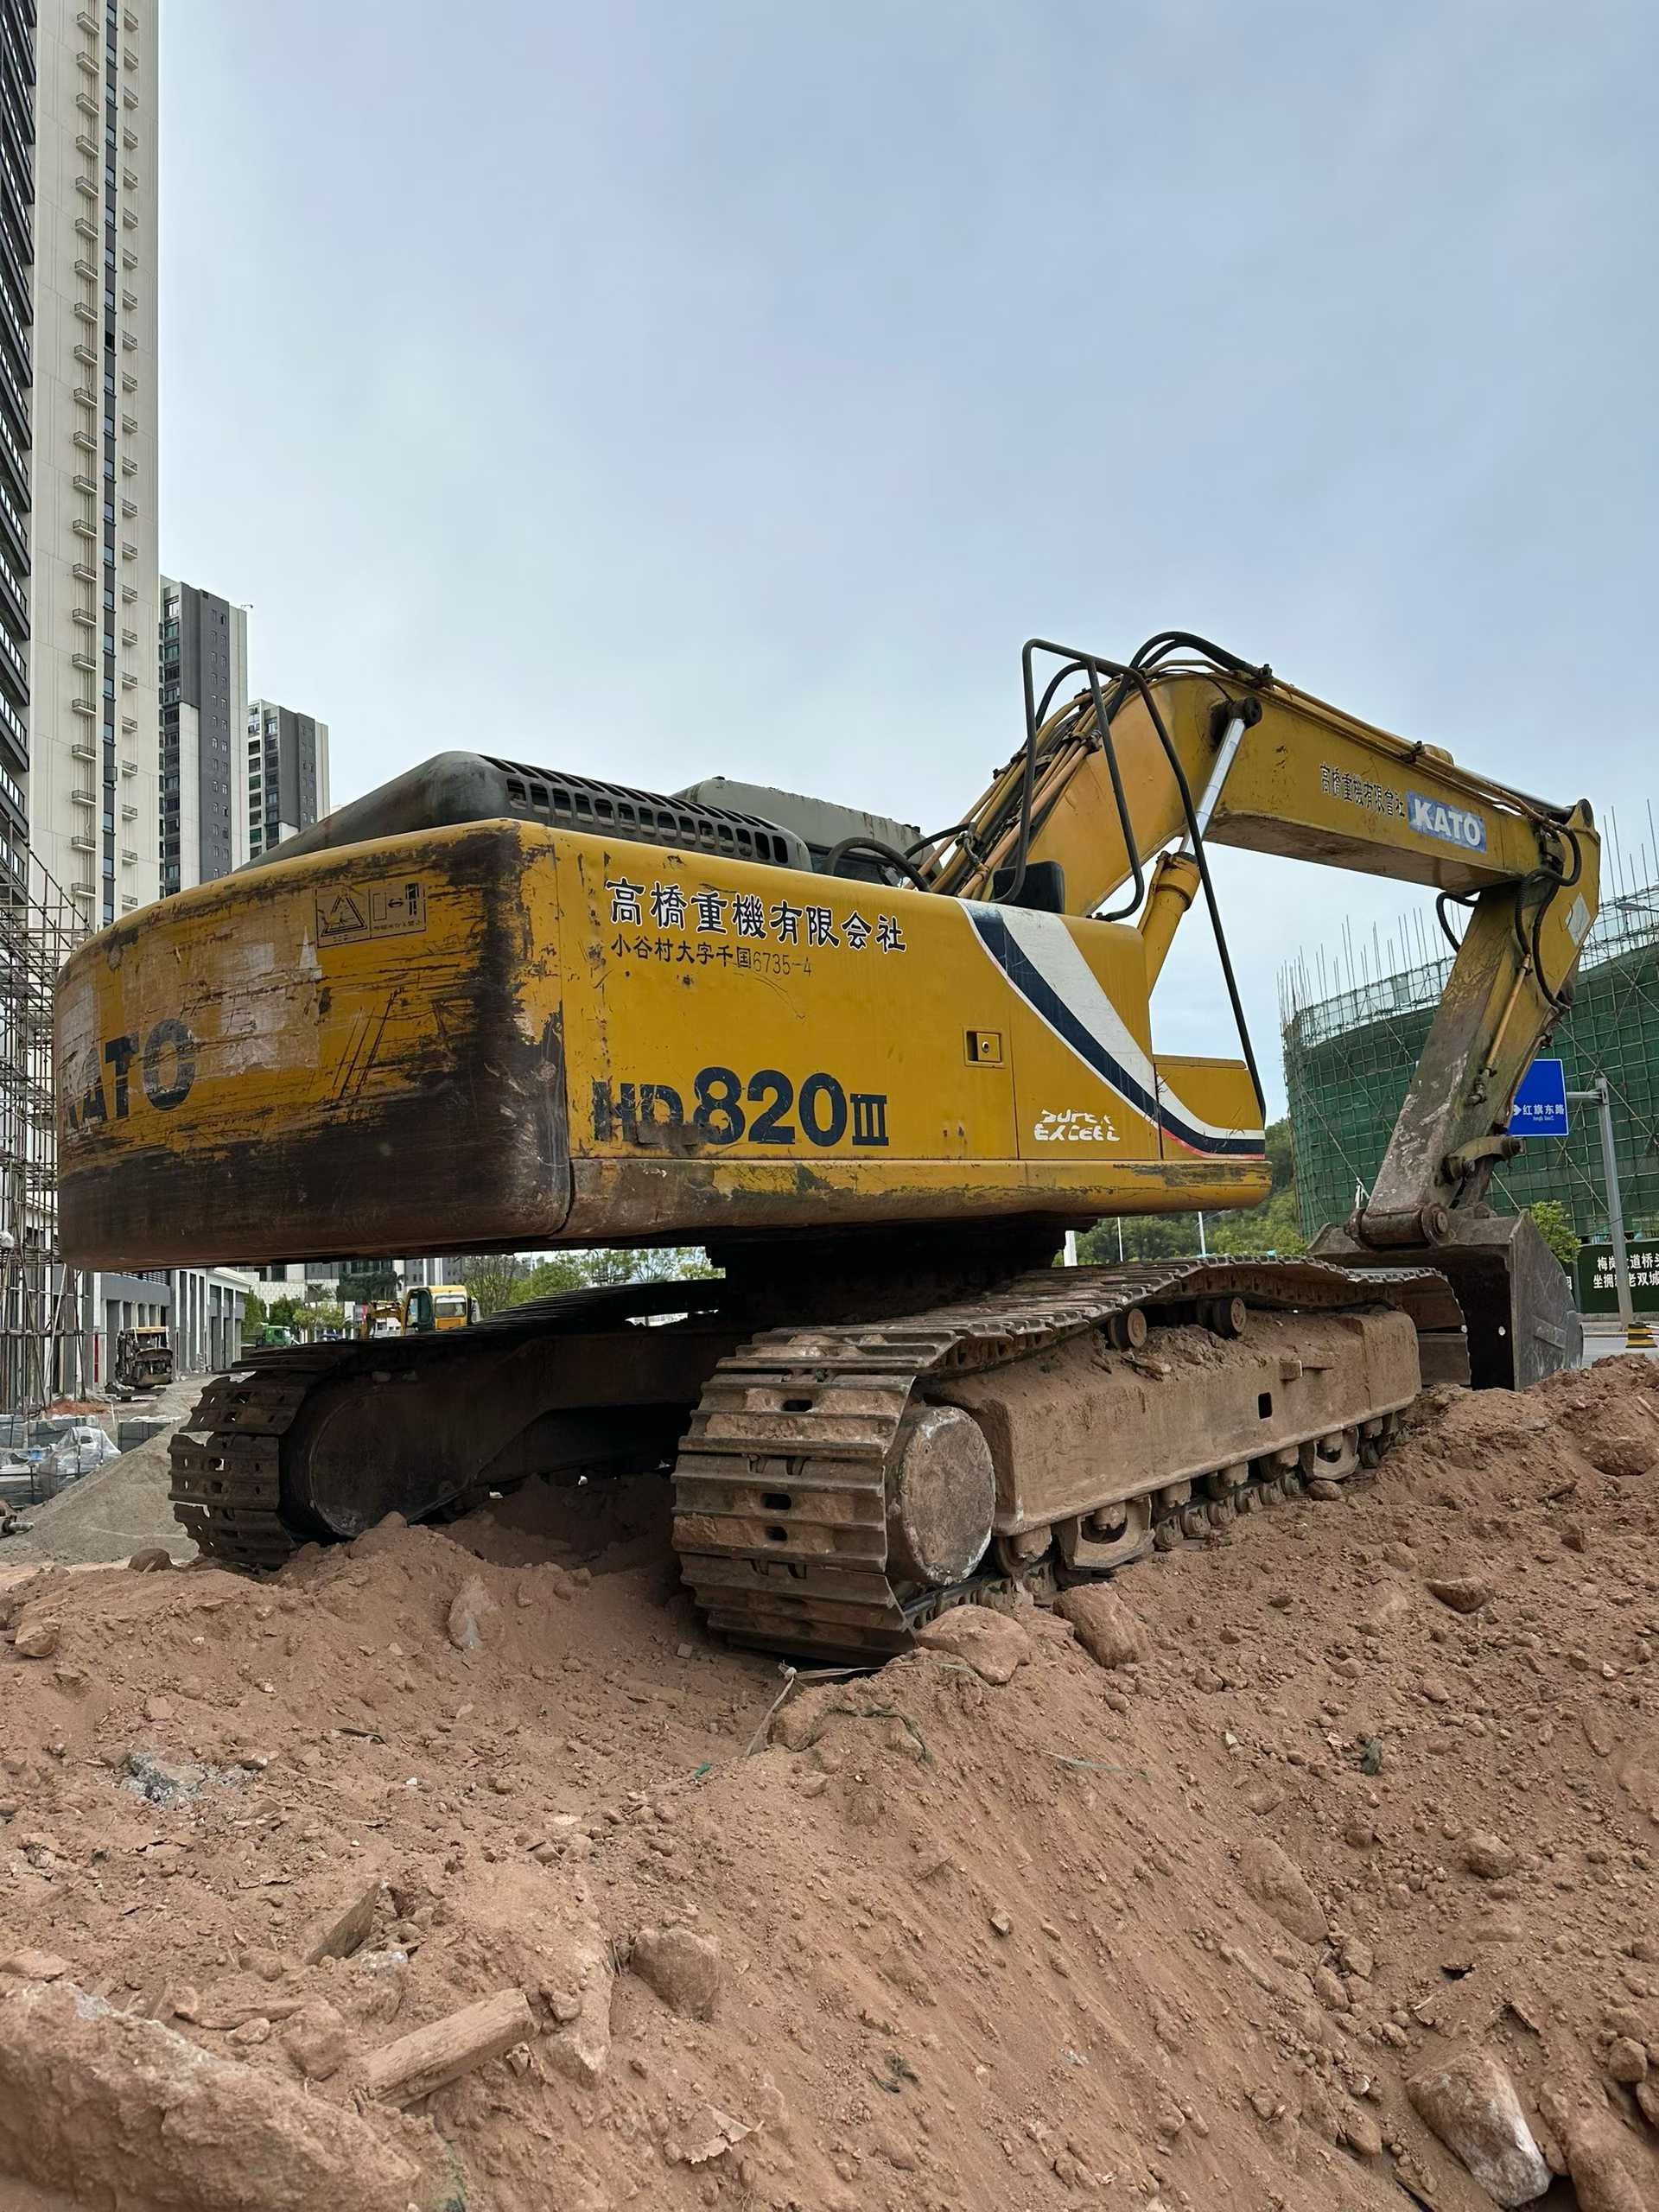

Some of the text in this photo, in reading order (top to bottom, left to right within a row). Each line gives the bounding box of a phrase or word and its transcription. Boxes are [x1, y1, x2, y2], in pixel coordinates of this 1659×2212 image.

[1414, 798, 1481, 846] KATO
[606, 877, 907, 954] 高橋重機有限会社
[65, 1018, 196, 1130] ATO
[1592, 1270, 1659, 1289] 坐拥老双城
[1597, 1252, 1659, 1272] 梅岗道桥
